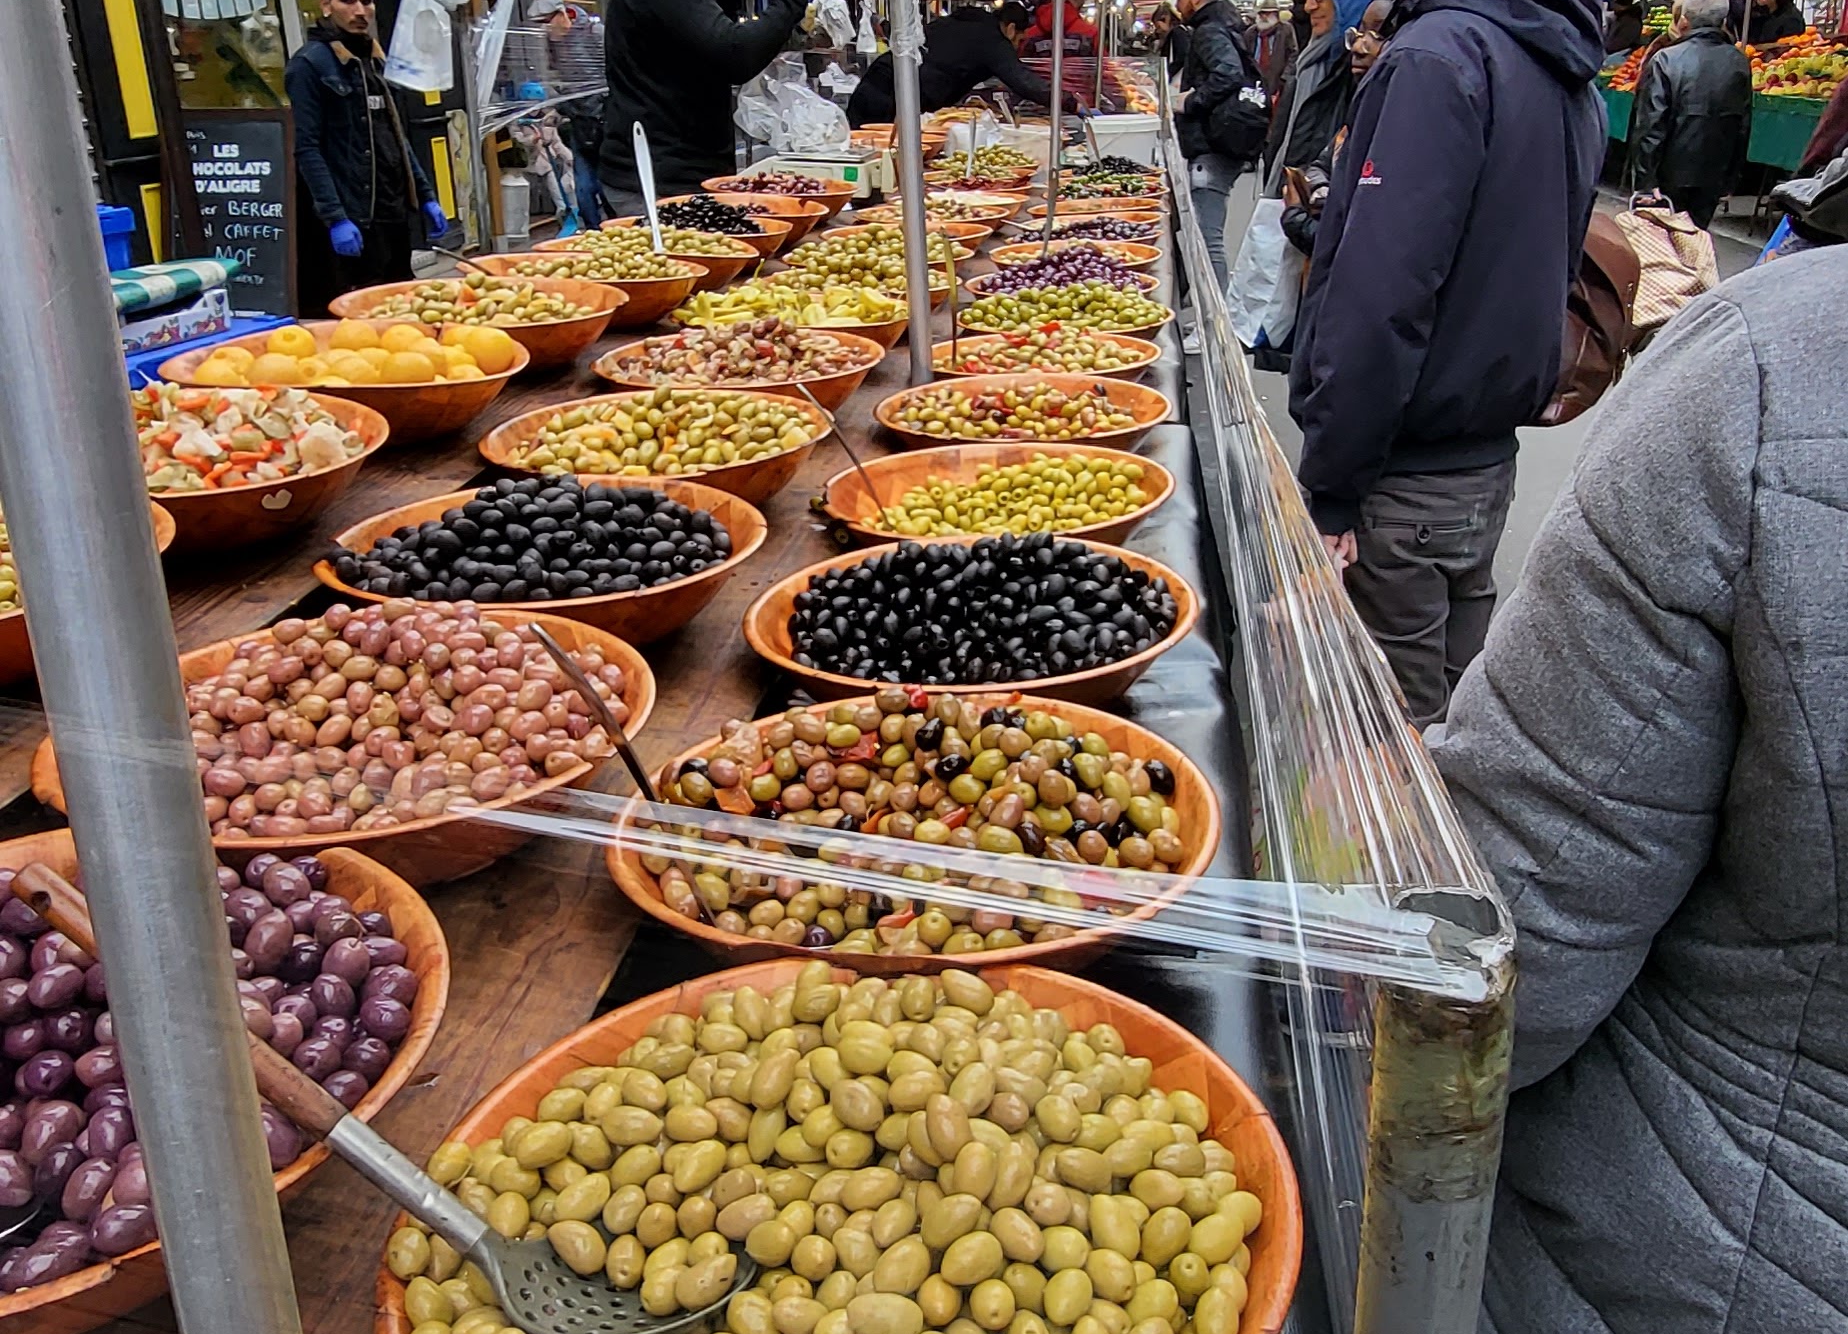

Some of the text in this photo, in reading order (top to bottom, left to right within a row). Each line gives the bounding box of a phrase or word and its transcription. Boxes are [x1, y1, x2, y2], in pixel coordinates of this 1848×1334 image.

[213, 144, 240, 158] LES
[192, 161, 271, 175] HOCOLATS
[194, 179, 261, 193] D'ALIGRE
[227, 200, 283, 217] BERGER
[224, 223, 285, 241] CAFFET
